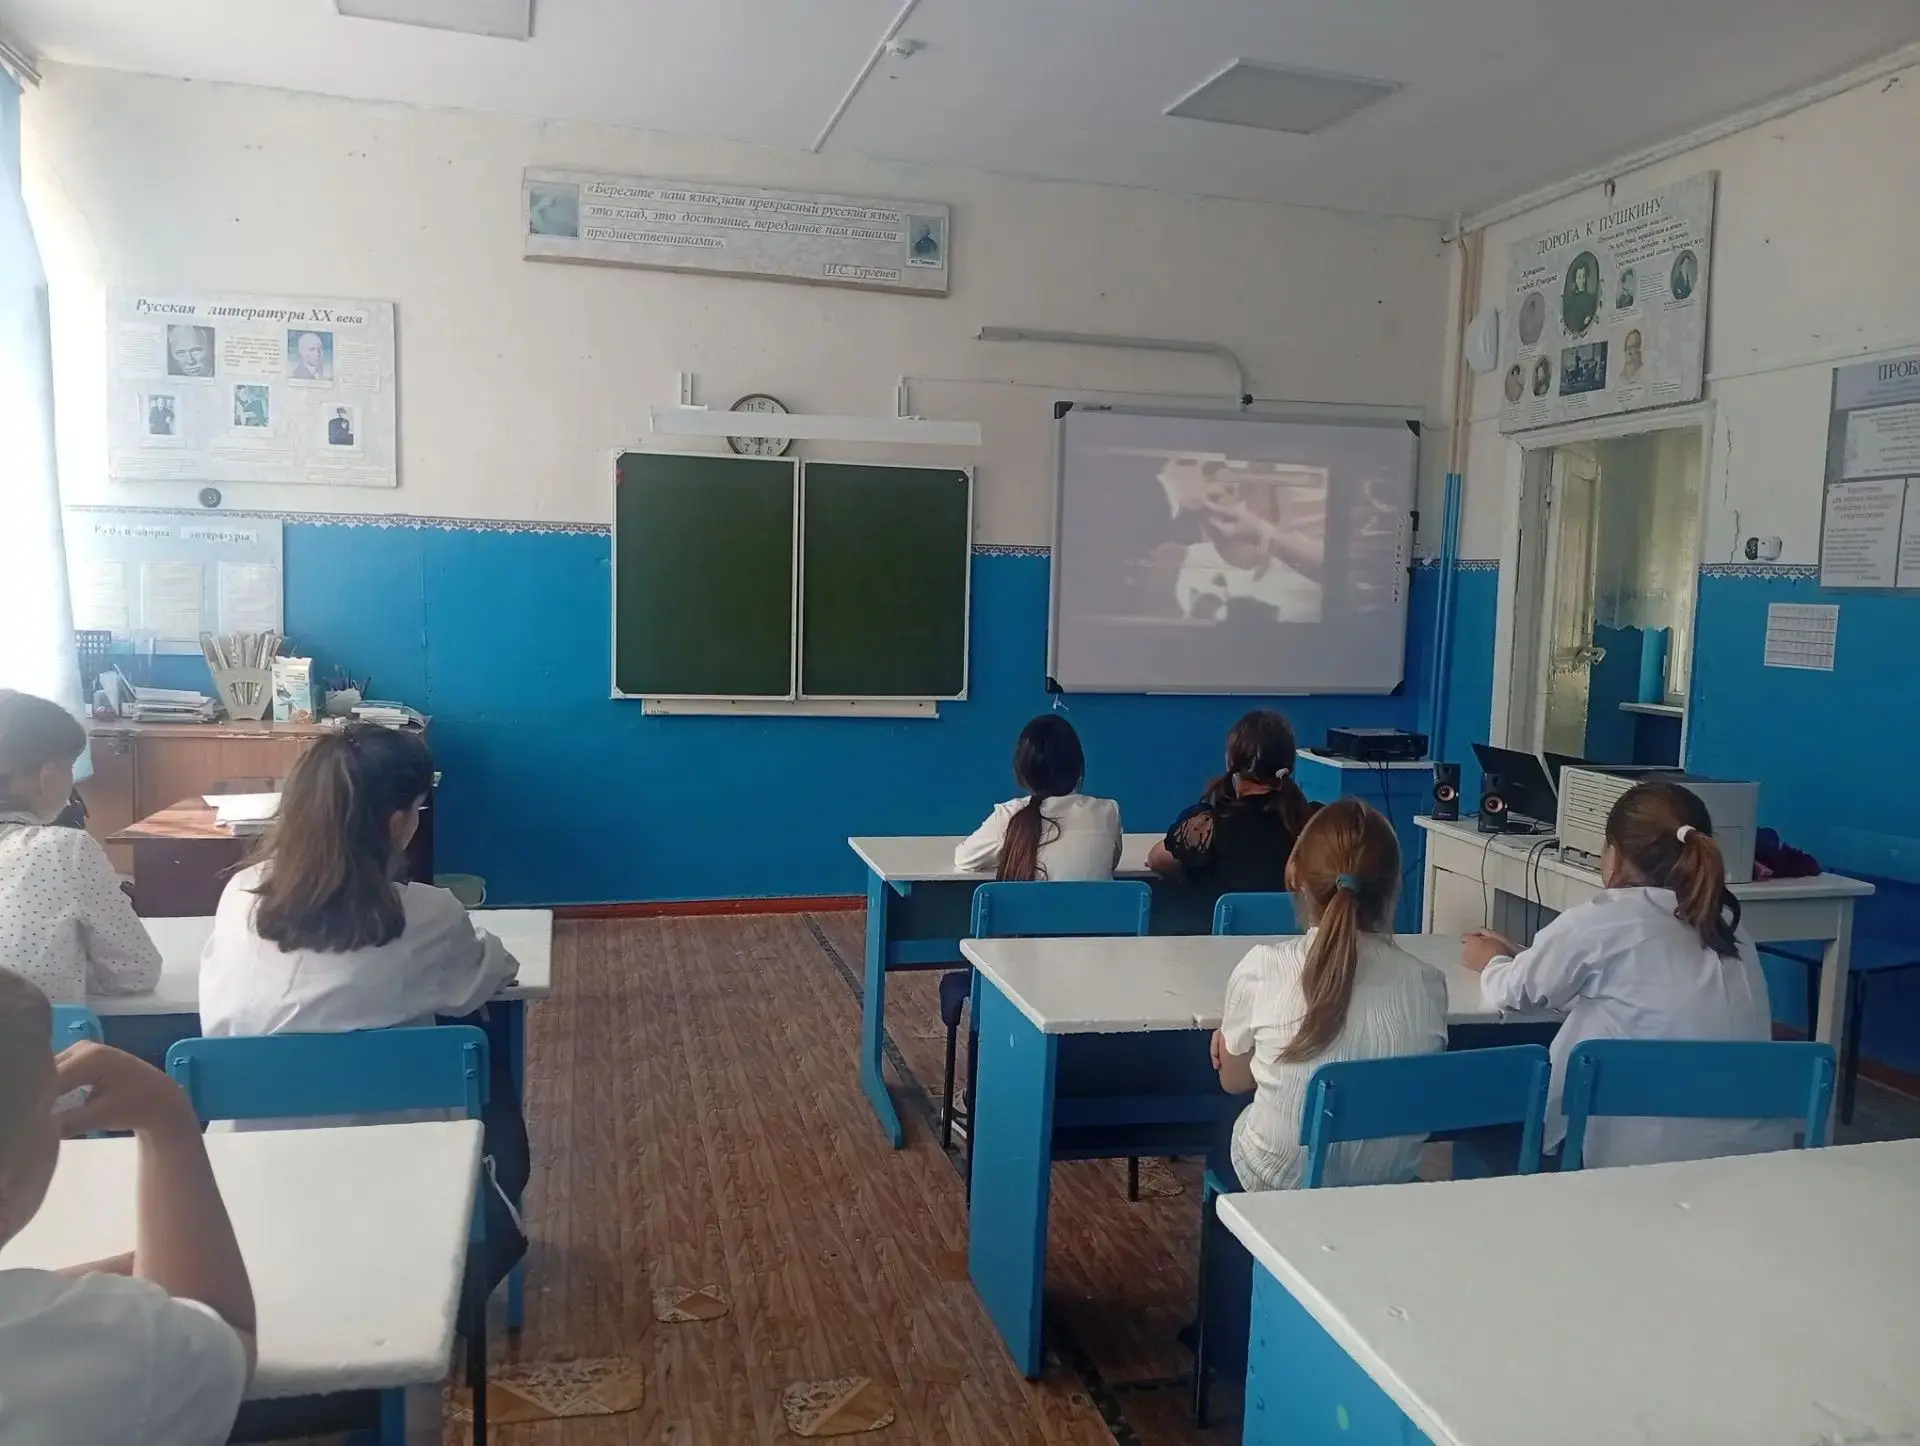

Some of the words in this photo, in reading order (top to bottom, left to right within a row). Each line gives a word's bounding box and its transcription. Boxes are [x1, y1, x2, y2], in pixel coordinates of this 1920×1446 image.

[587, 182, 655, 200] «Берегите
[660, 190, 686, 201] наш
[749, 199, 818, 215] прекрасный
[821, 205, 867, 218] русский
[590, 206, 613, 217] это
[616, 208, 648, 220] клад,
[653, 212, 676, 222] это
[681, 211, 751, 228] достояние,
[754, 219, 822, 234] переданное
[825, 226, 848, 237] нам
[851, 229, 897, 241] нашими
[1537, 228, 1580, 256] ДОРОГА
[1585, 220, 1595, 236] К
[1599, 196, 1664, 232] ПУШКИНУ
[852, 267, 897, 280] Тургенев
[135, 298, 196, 315] Русская
[208, 304, 305, 323] литература
[336, 314, 363, 325] века
[746, 403, 754, 412] 11
[757, 401, 765, 410] 12
